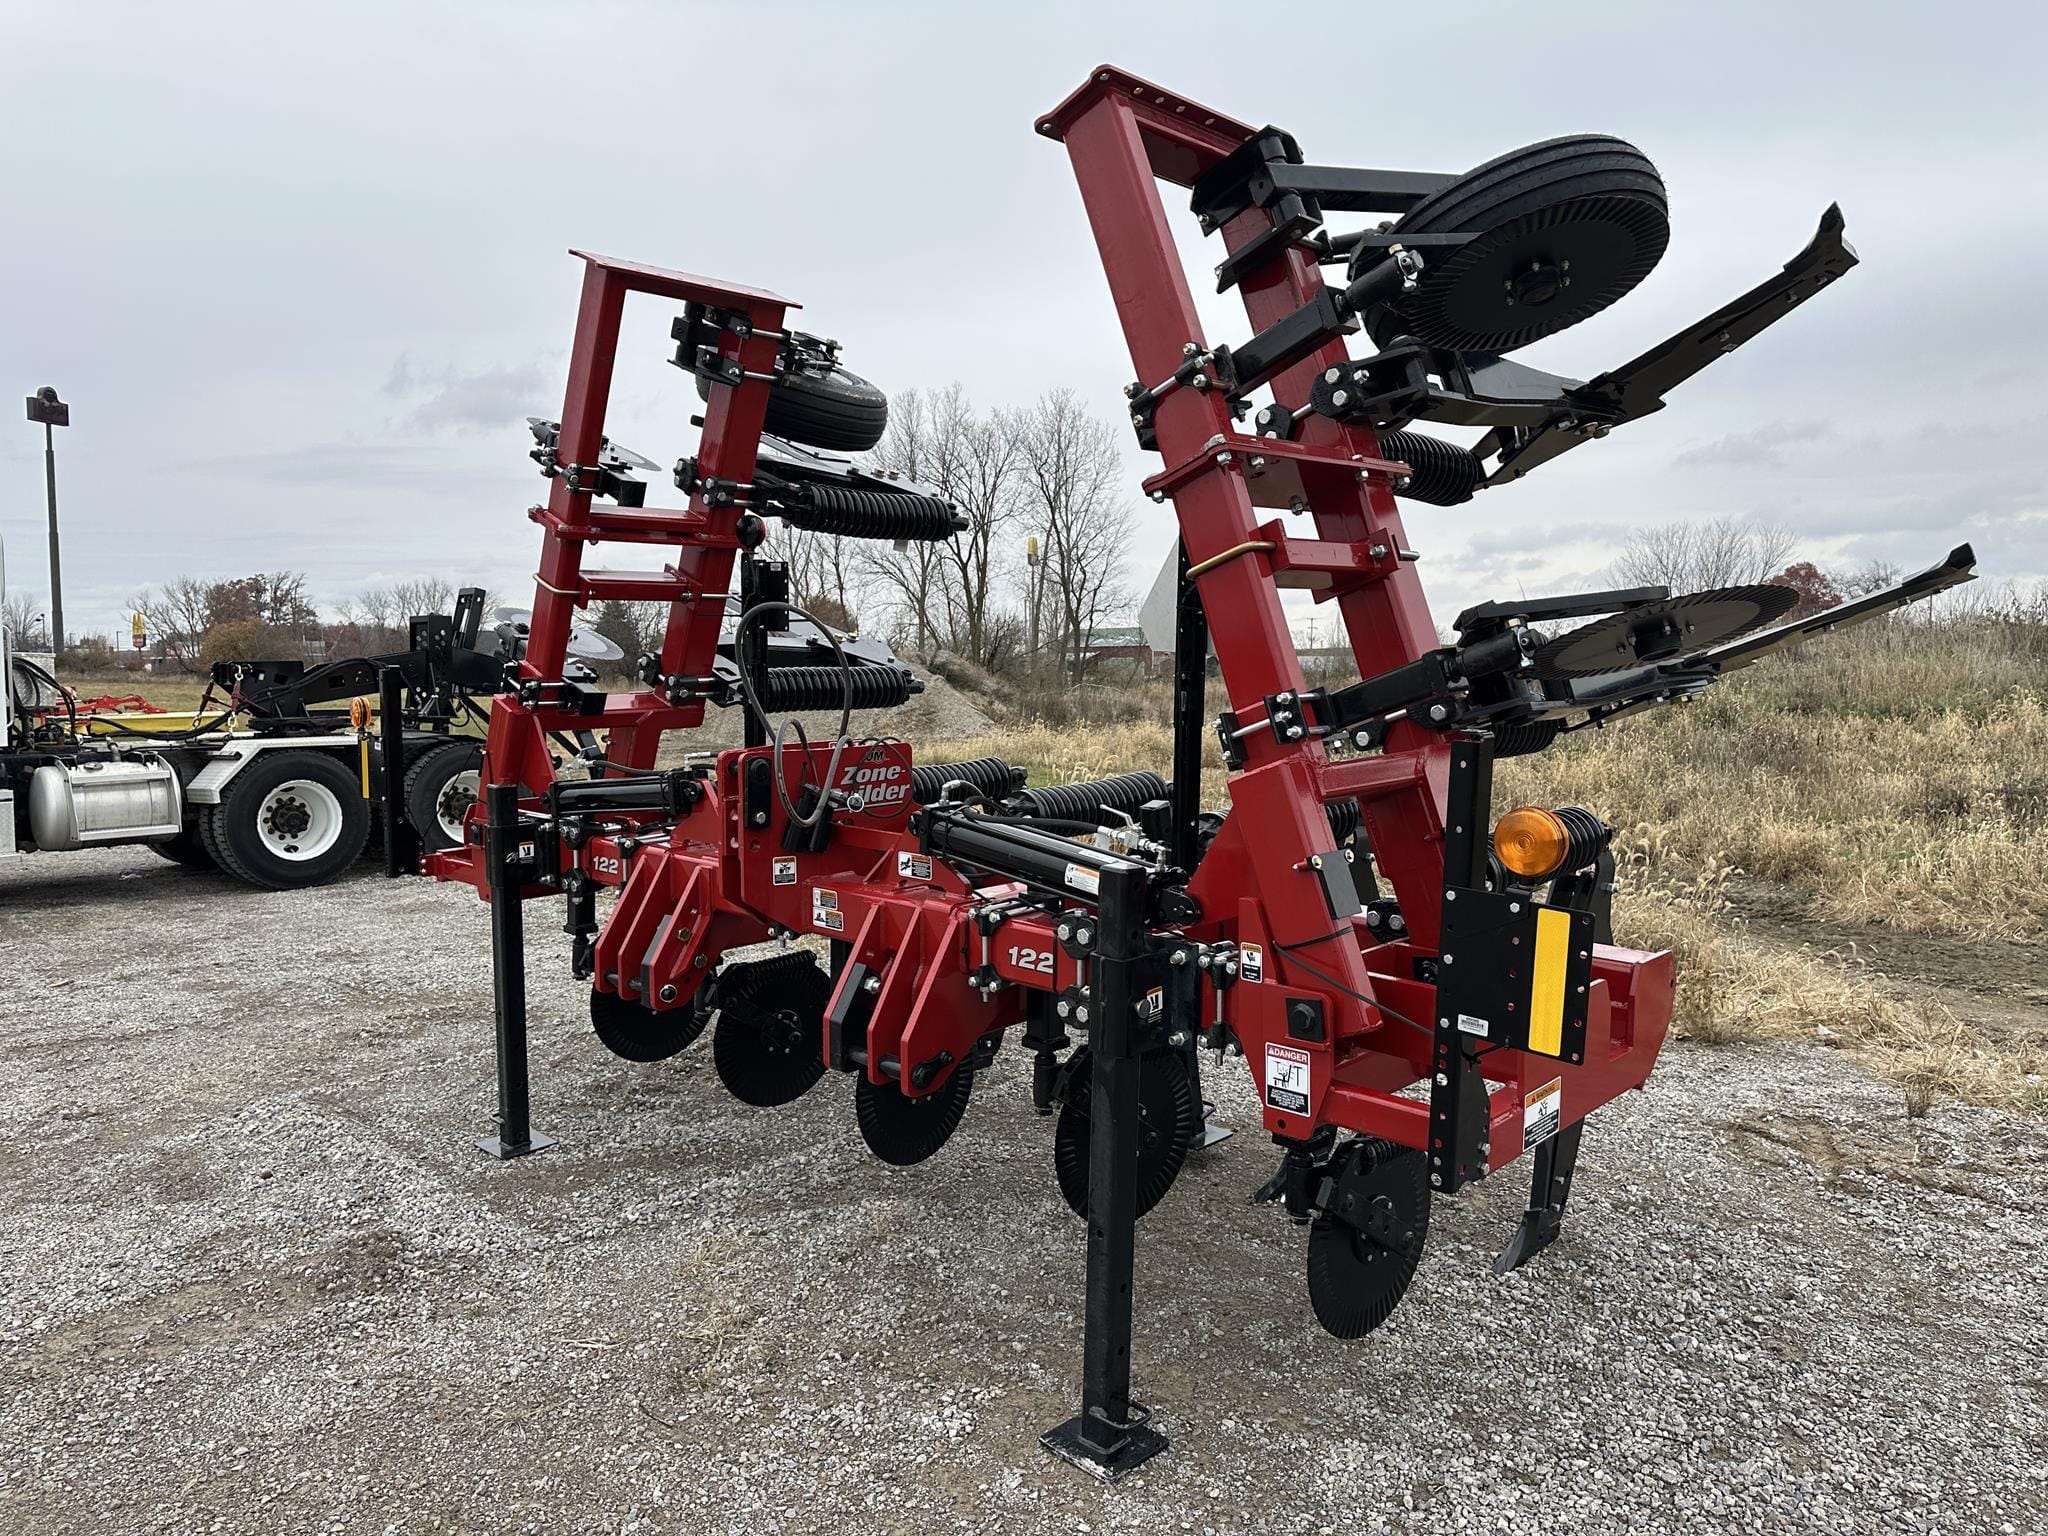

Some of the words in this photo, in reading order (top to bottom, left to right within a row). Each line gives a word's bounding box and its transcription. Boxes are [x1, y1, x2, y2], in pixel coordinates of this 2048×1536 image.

[840, 765, 906, 785] Zone-
[593, 855, 619, 874] 122
[1008, 946, 1054, 974] 122
[1274, 1048, 1307, 1063] DANGER
